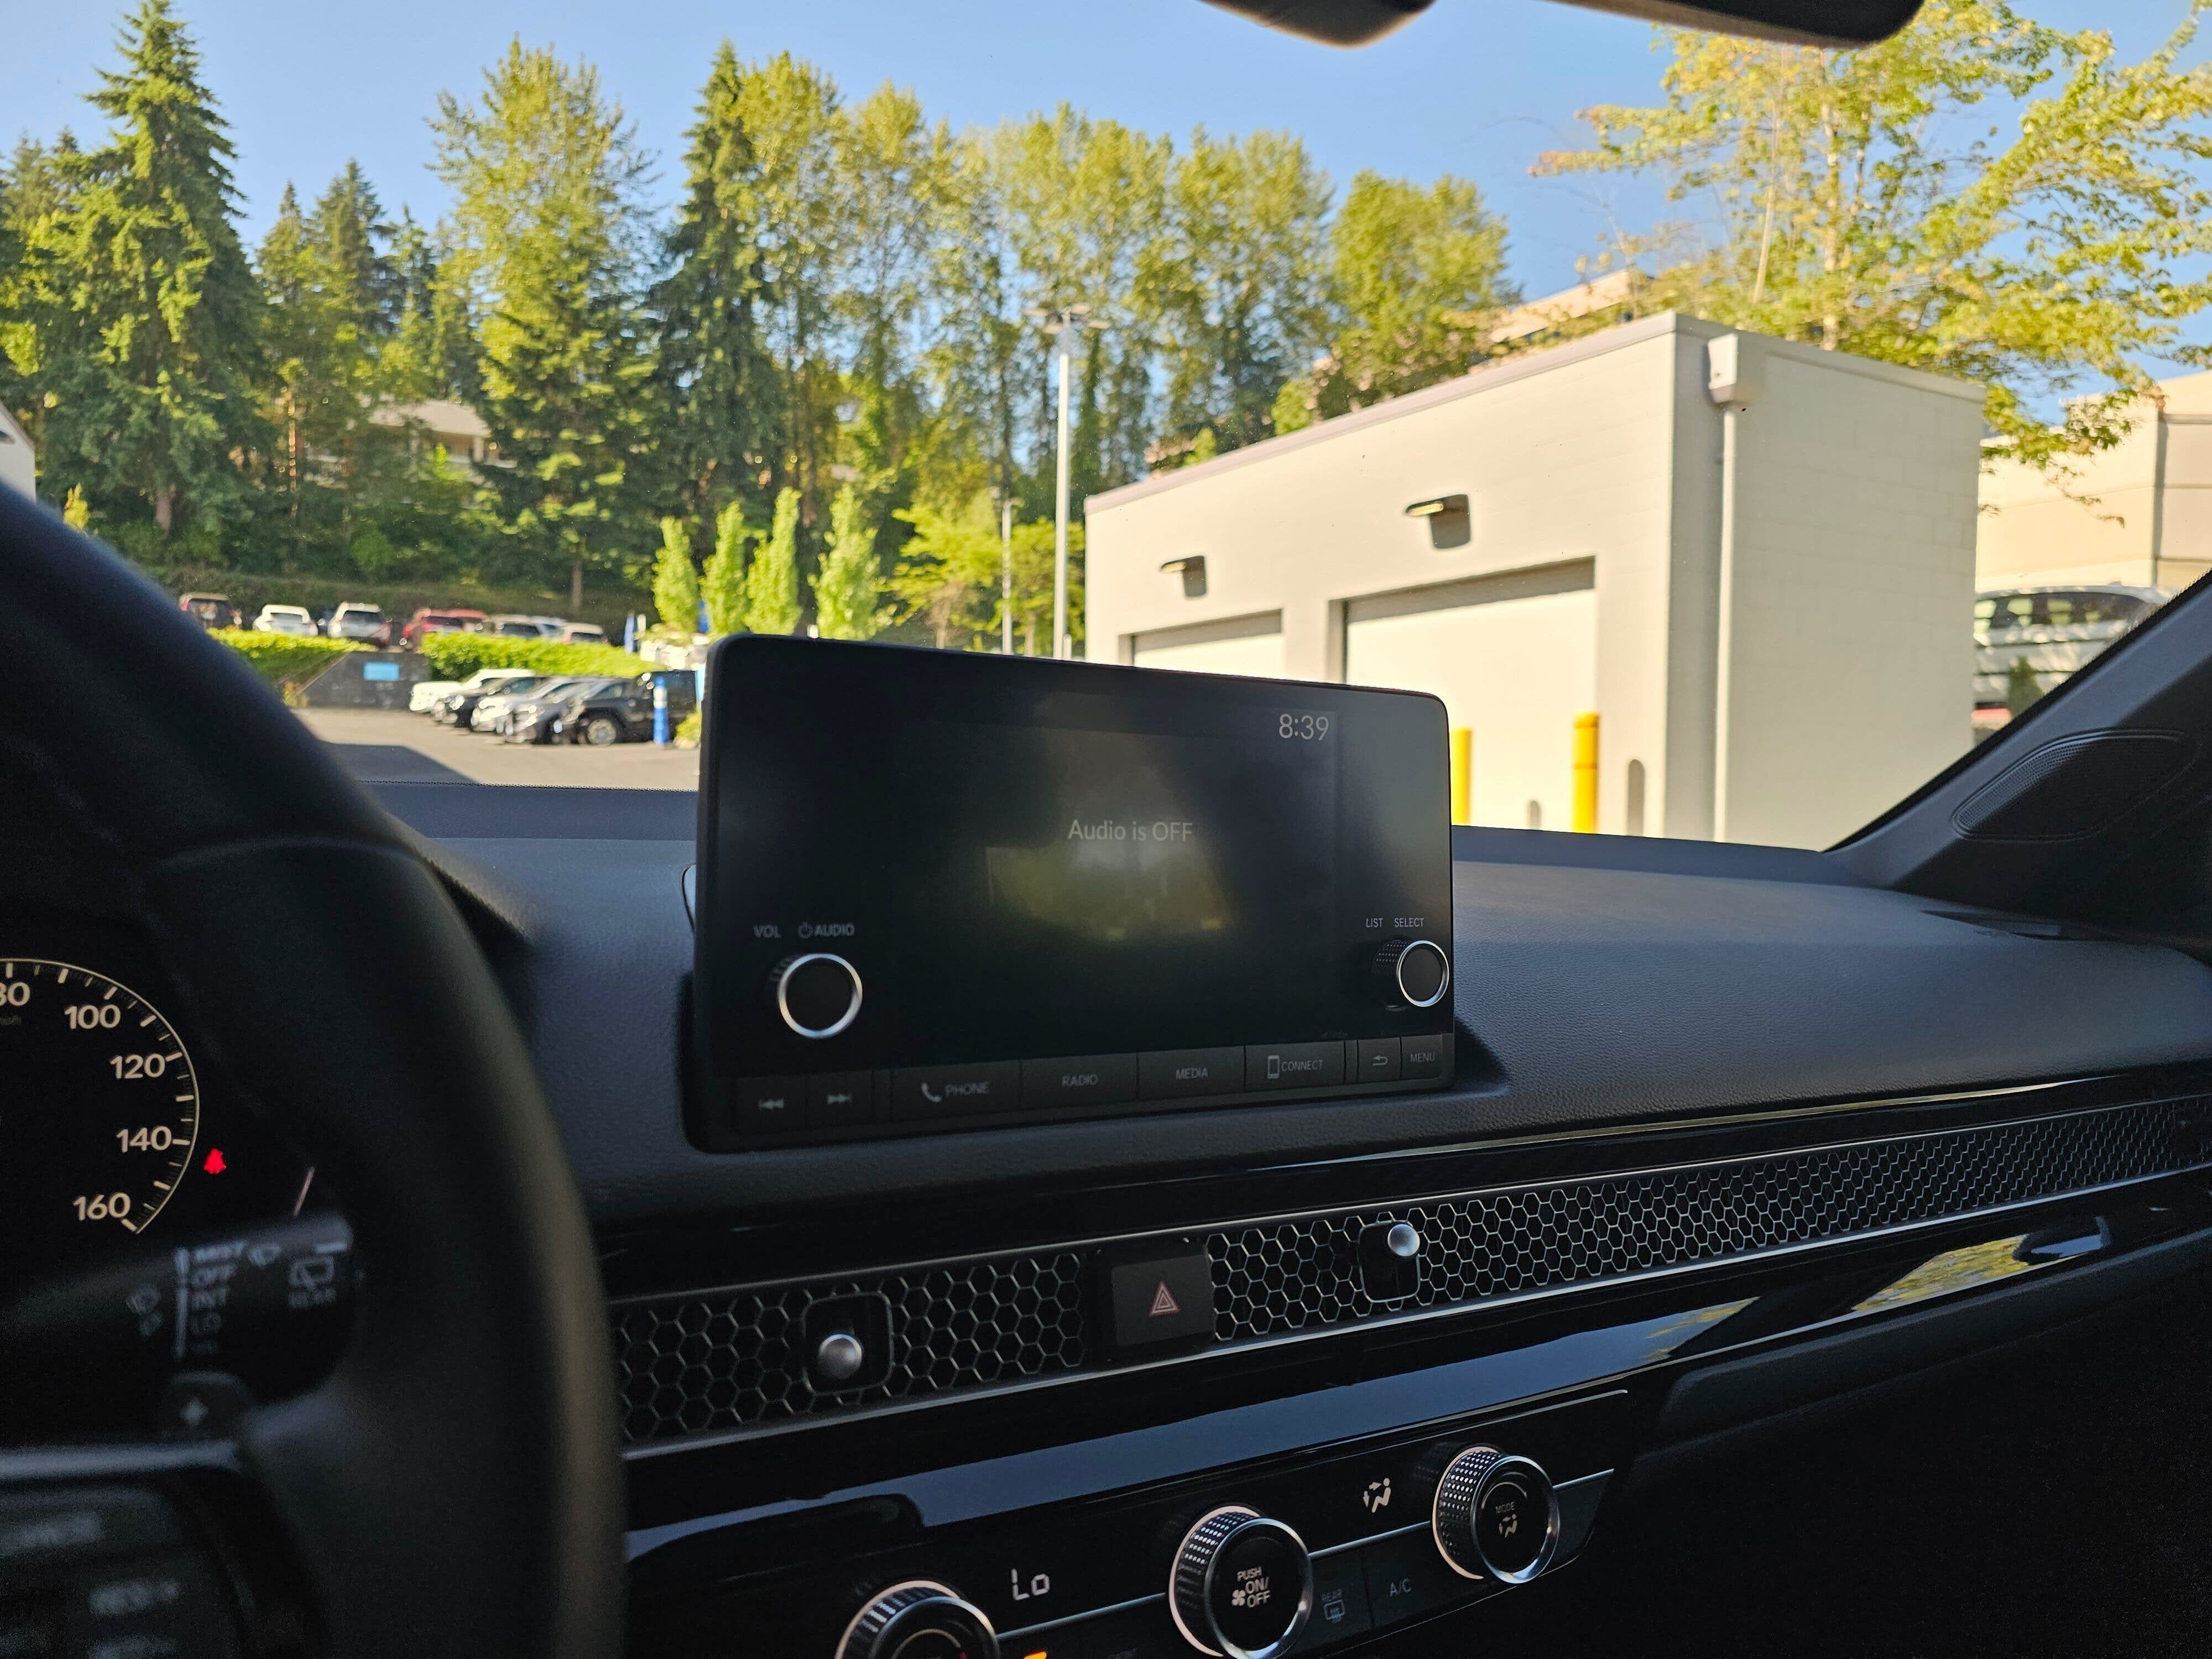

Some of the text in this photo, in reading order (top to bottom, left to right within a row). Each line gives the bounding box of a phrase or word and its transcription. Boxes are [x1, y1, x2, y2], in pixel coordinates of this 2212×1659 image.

[1279, 713, 1329, 741] 8:39
[1068, 820, 1193, 842] Audio is OFF
[753, 923, 855, 938] VOL AUDIO
[1365, 917, 1425, 928] LIST SELECT
[64, 1004, 121, 1030] 100
[110, 1053, 165, 1079] 120
[1281, 1059, 1323, 1072] CONNECT
[1410, 1051, 1435, 1063] MENU
[1062, 1073, 1098, 1087] RADIO
[1176, 1067, 1209, 1080] MEDIA
[945, 1081, 989, 1097] PHONE
[116, 1125, 172, 1153] 140
[73, 1192, 131, 1221] 160
[1495, 1501, 1515, 1514] MODE
[1237, 1566, 1262, 1582] PUSH
[1011, 1569, 1050, 1601] Lo
[1245, 1576, 1270, 1594] ON/
[1390, 1578, 1412, 1597] A/C
[1246, 1590, 1271, 1608] OFF
